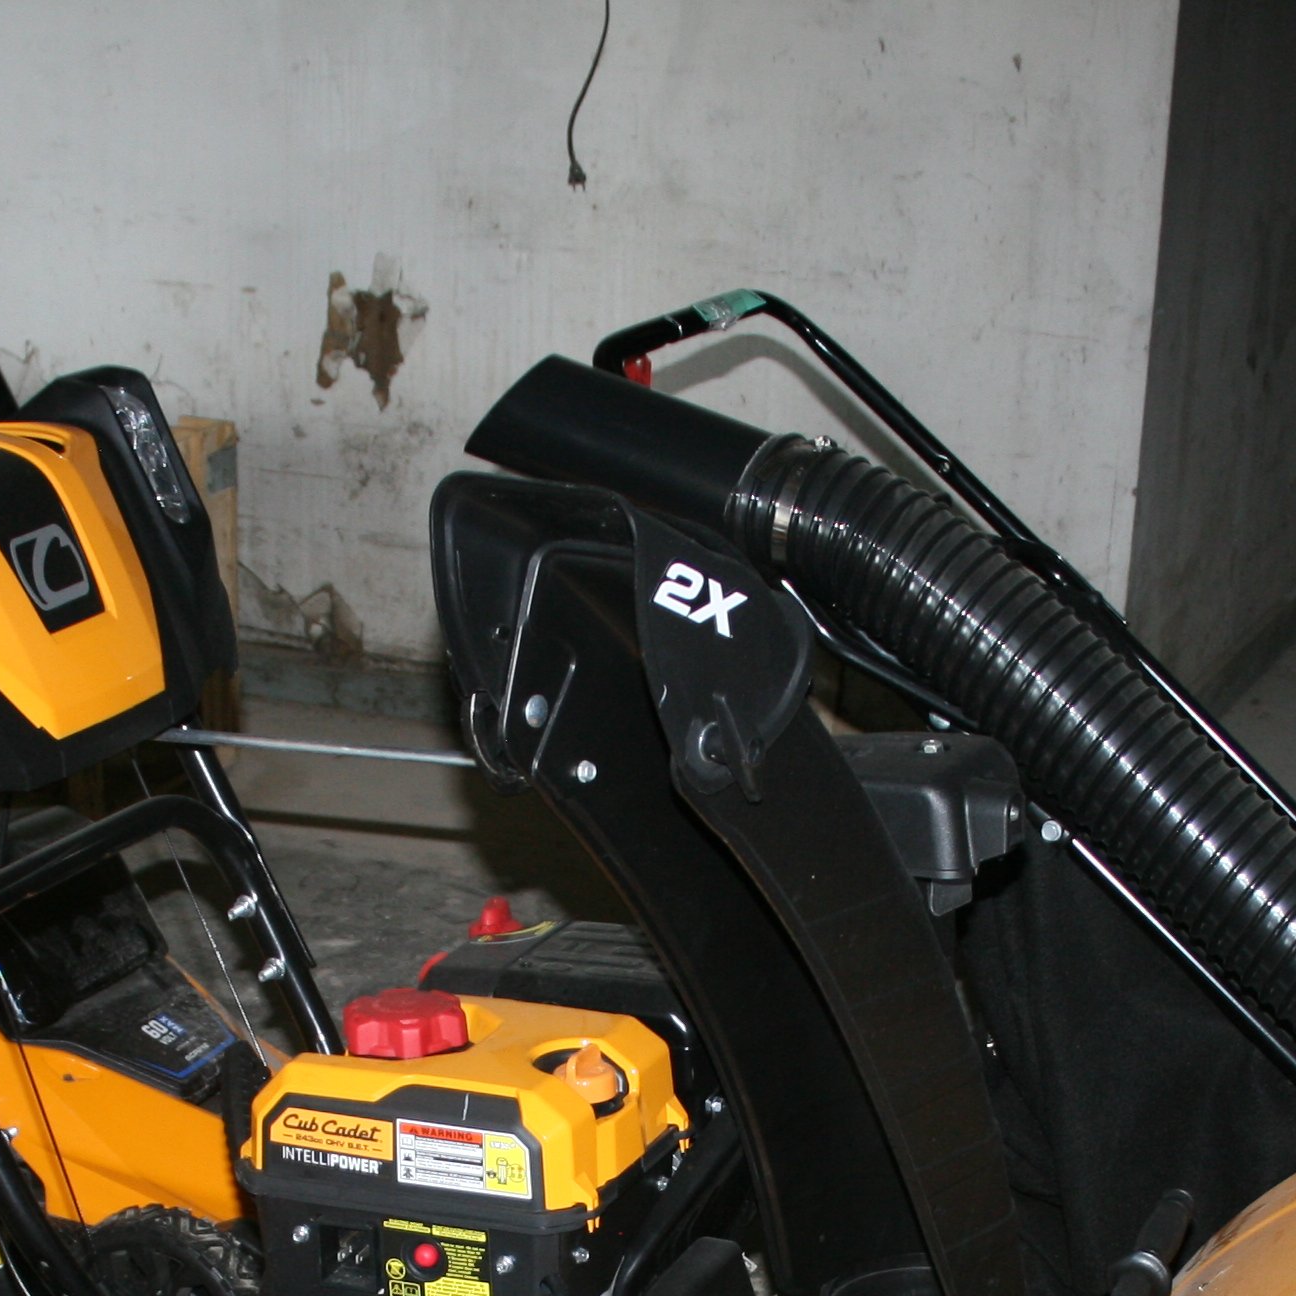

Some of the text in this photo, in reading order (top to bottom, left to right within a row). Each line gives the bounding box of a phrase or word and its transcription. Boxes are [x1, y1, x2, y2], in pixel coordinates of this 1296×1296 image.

[653, 562, 748, 638] 2X
[141, 1019, 169, 1040] 60
[283, 1113, 382, 1142] Cub Cadet
[421, 1126, 473, 1142] WARNING
[282, 1146, 381, 1175] INTELLIPOWER
